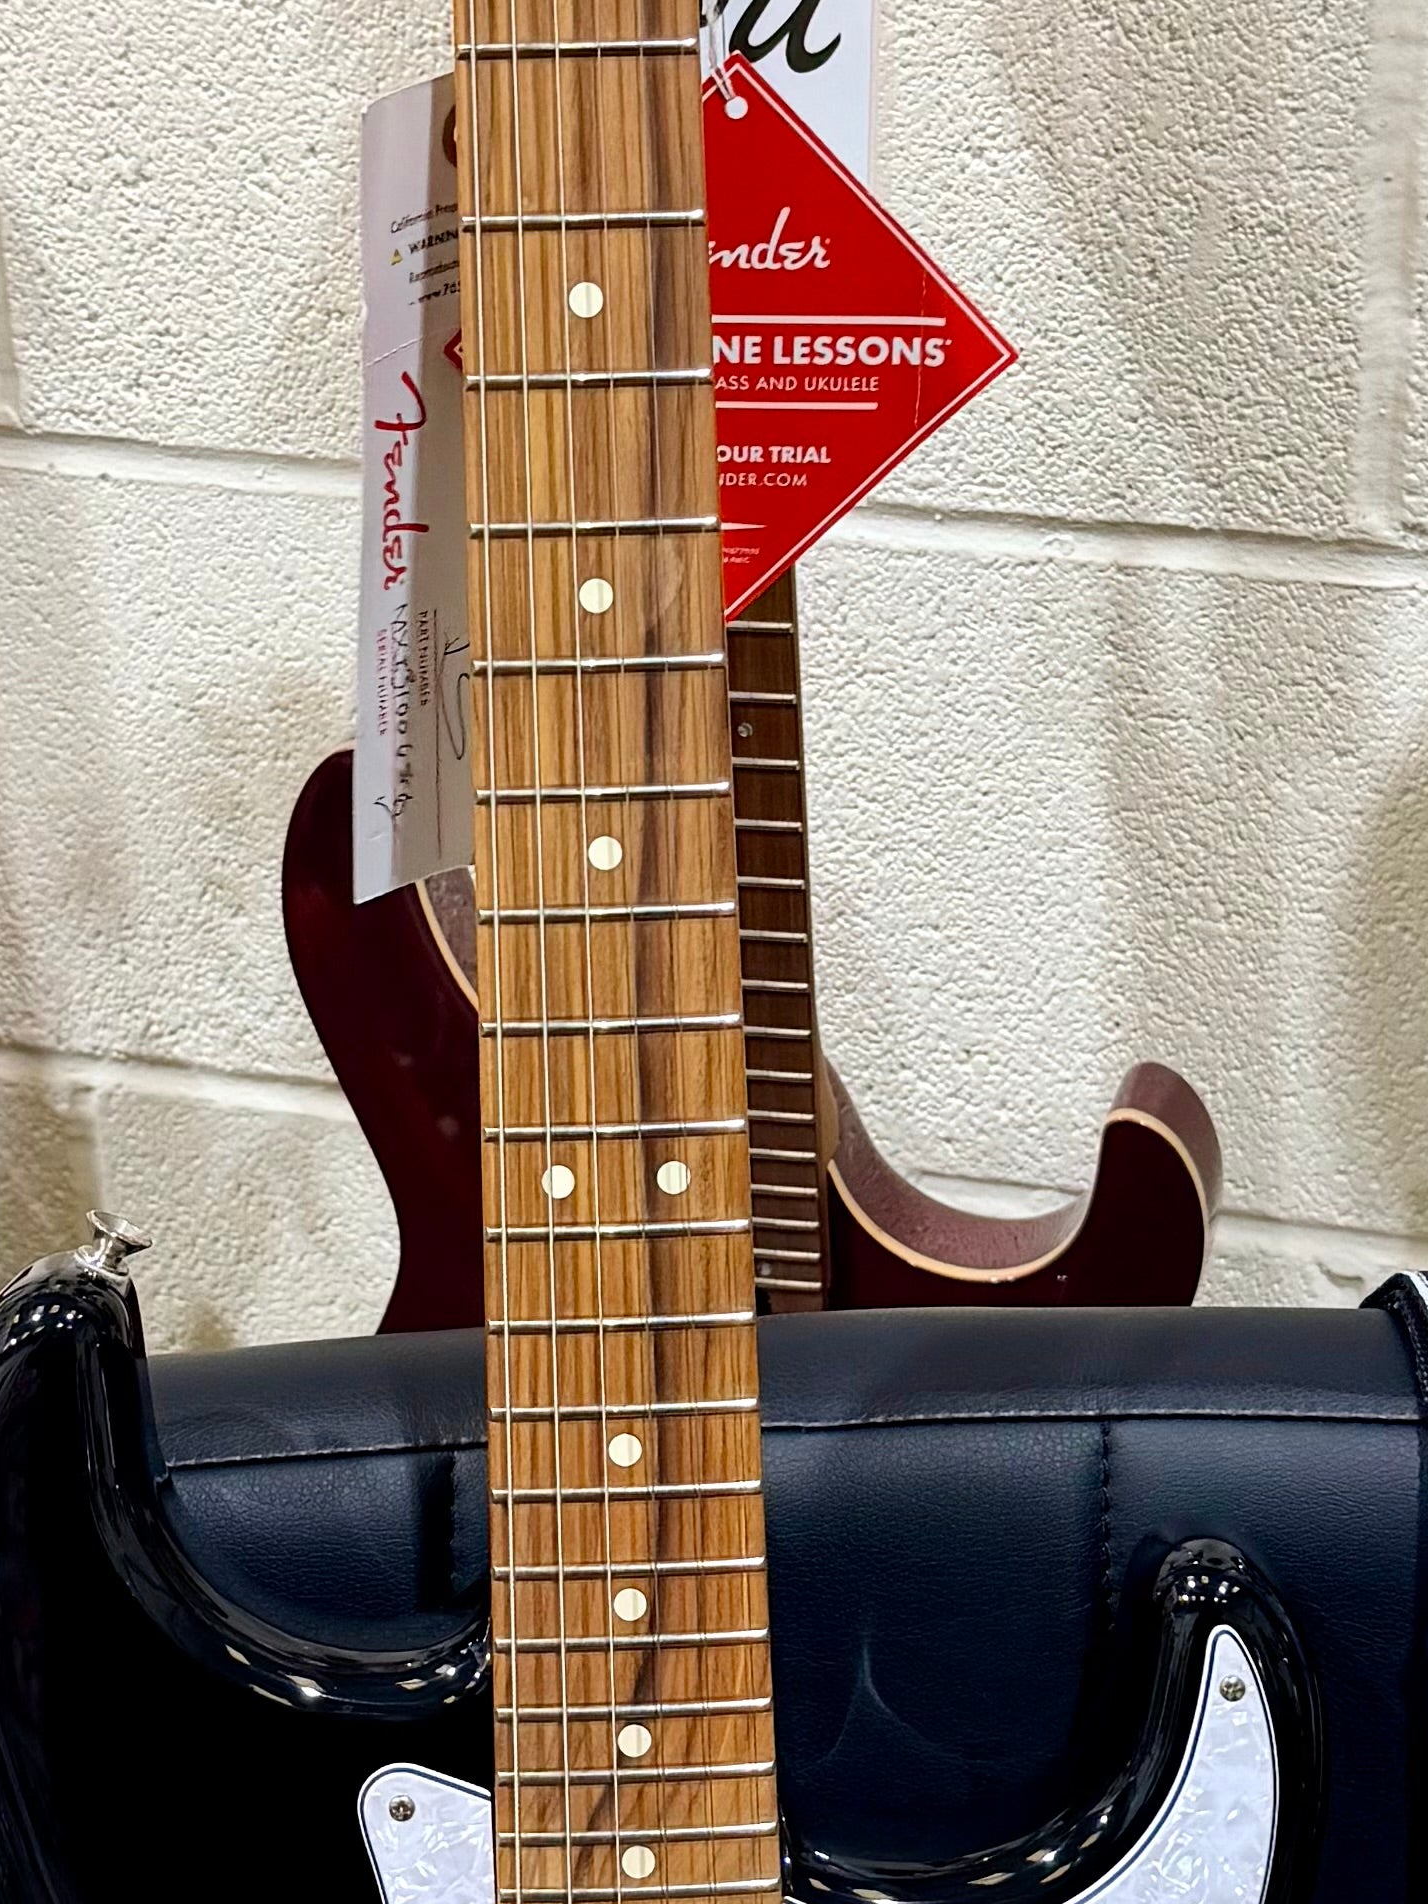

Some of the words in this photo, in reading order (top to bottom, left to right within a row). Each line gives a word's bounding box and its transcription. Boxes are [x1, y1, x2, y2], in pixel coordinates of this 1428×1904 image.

[755, 375, 798, 392] AND
[804, 375, 881, 392] UKULELE
[768, 444, 832, 464] TRIAL
